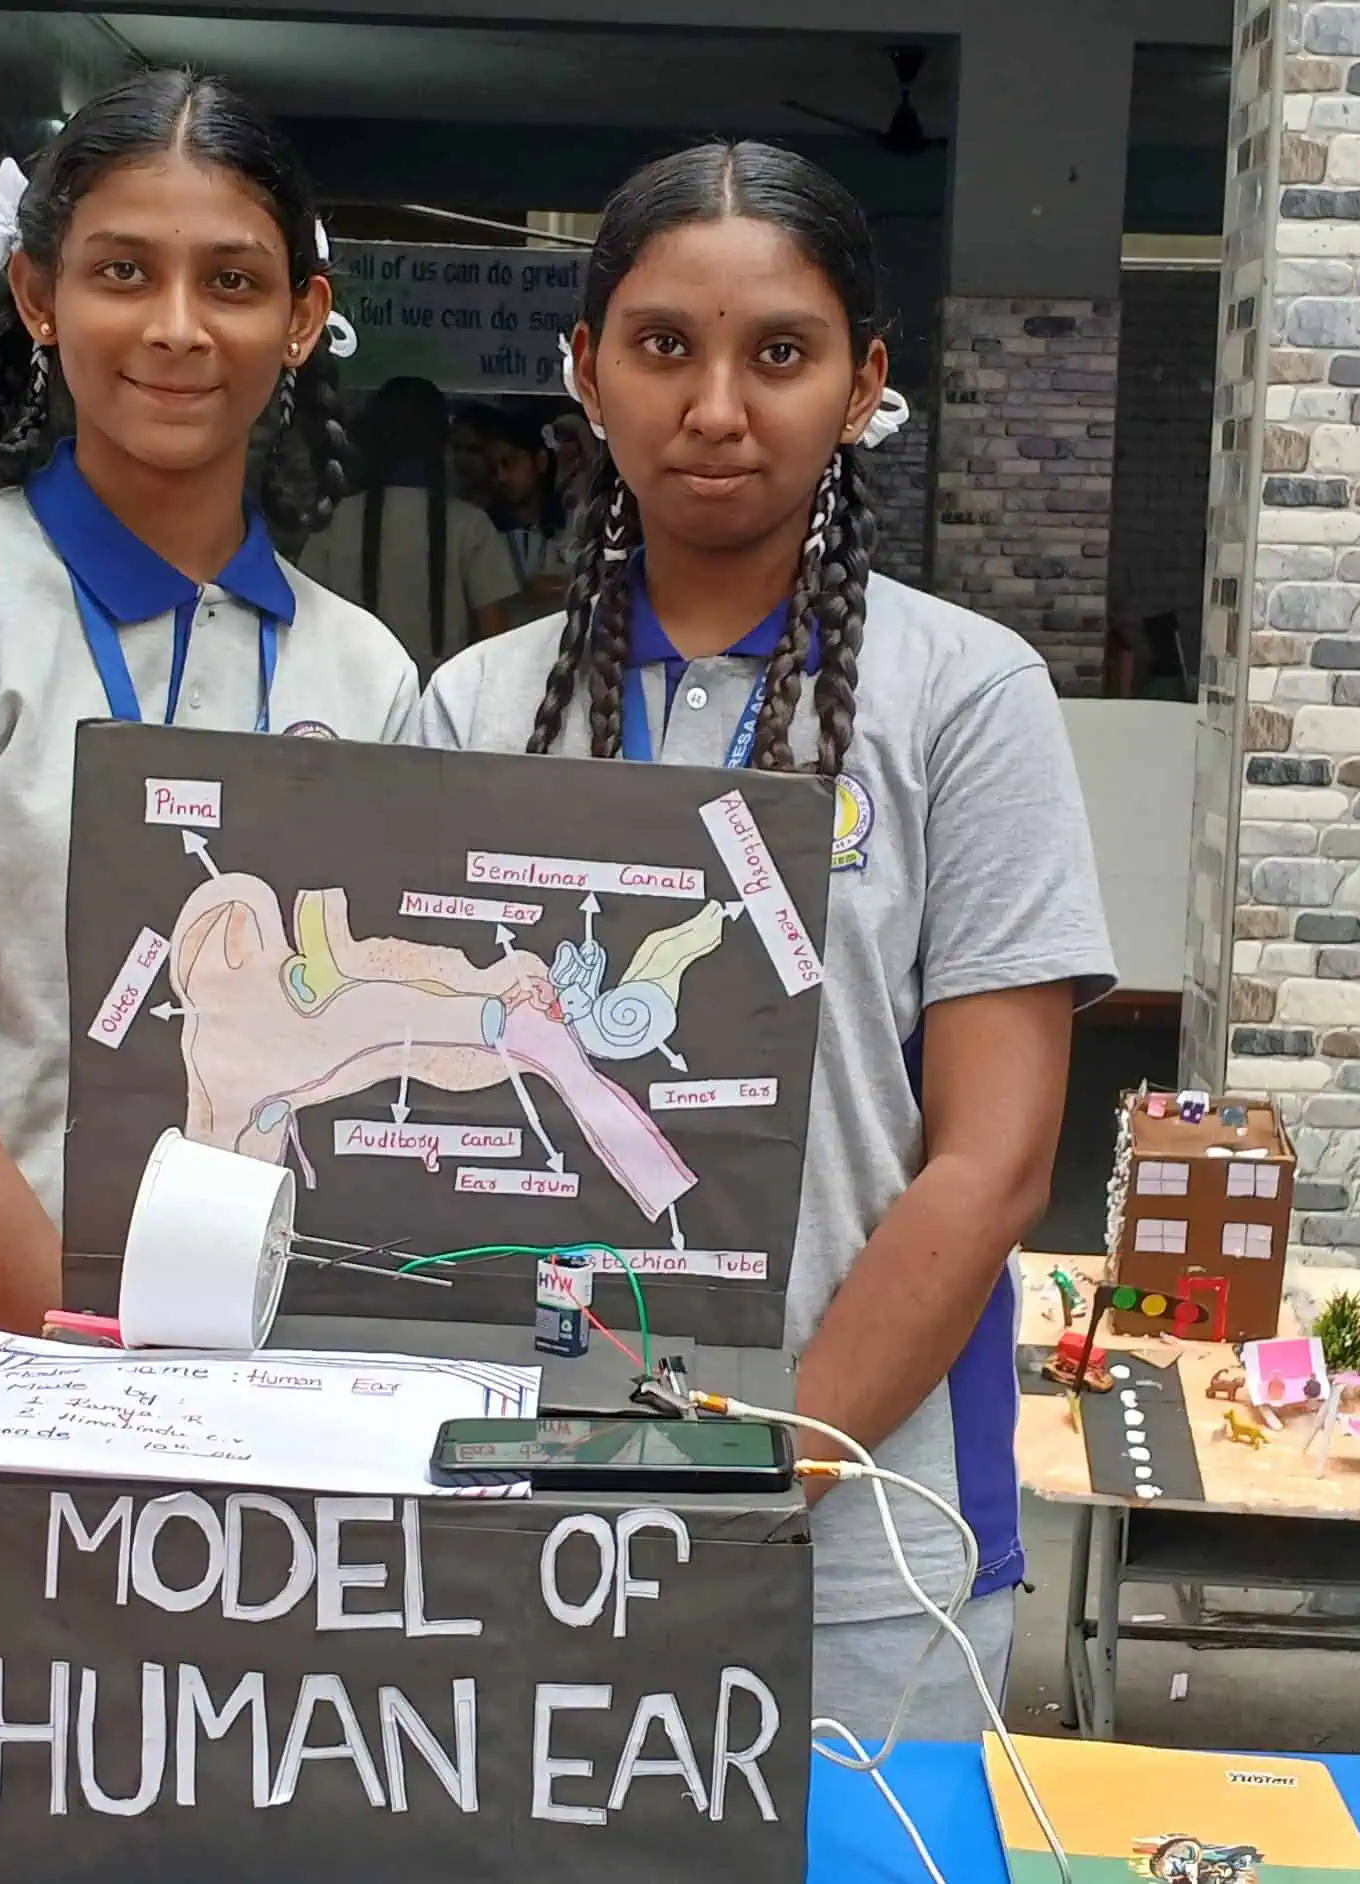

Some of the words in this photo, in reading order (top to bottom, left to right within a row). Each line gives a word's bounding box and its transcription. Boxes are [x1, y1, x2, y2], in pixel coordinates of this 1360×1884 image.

[382, 255, 405, 280] of
[412, 260, 438, 281] us
[444, 260, 480, 283] can
[488, 259, 513, 286] do
[522, 257, 581, 292] great
[401, 306, 434, 328] we
[441, 306, 481, 330] can
[492, 303, 518, 331] do
[480, 346, 528, 377] with
[155, 788, 216, 819] Pinna
[471, 857, 589, 887] Semilunar
[619, 866, 697, 892] Canals
[718, 796, 772, 896] Auditory
[774, 907, 822, 983] nerves
[406, 893, 475, 918] Middle
[501, 903, 541, 922] Ear
[101, 984, 139, 1034] Outer
[137, 937, 164, 970] Ear
[664, 1088, 717, 1105] Inner
[739, 1084, 771, 1099] Ear
[346, 1126, 440, 1171] Auditory
[460, 1173, 497, 1192] Ear
[521, 1175, 577, 1194] drum
[711, 1252, 766, 1274] Tube
[538, 1271, 574, 1293] HYW
[247, 1368, 323, 1387] Human
[351, 1377, 402, 1393] Ear
[44, 1489, 483, 1638] MODEL
[540, 1507, 692, 1638] OF
[531, 1666, 780, 1827] EAR
